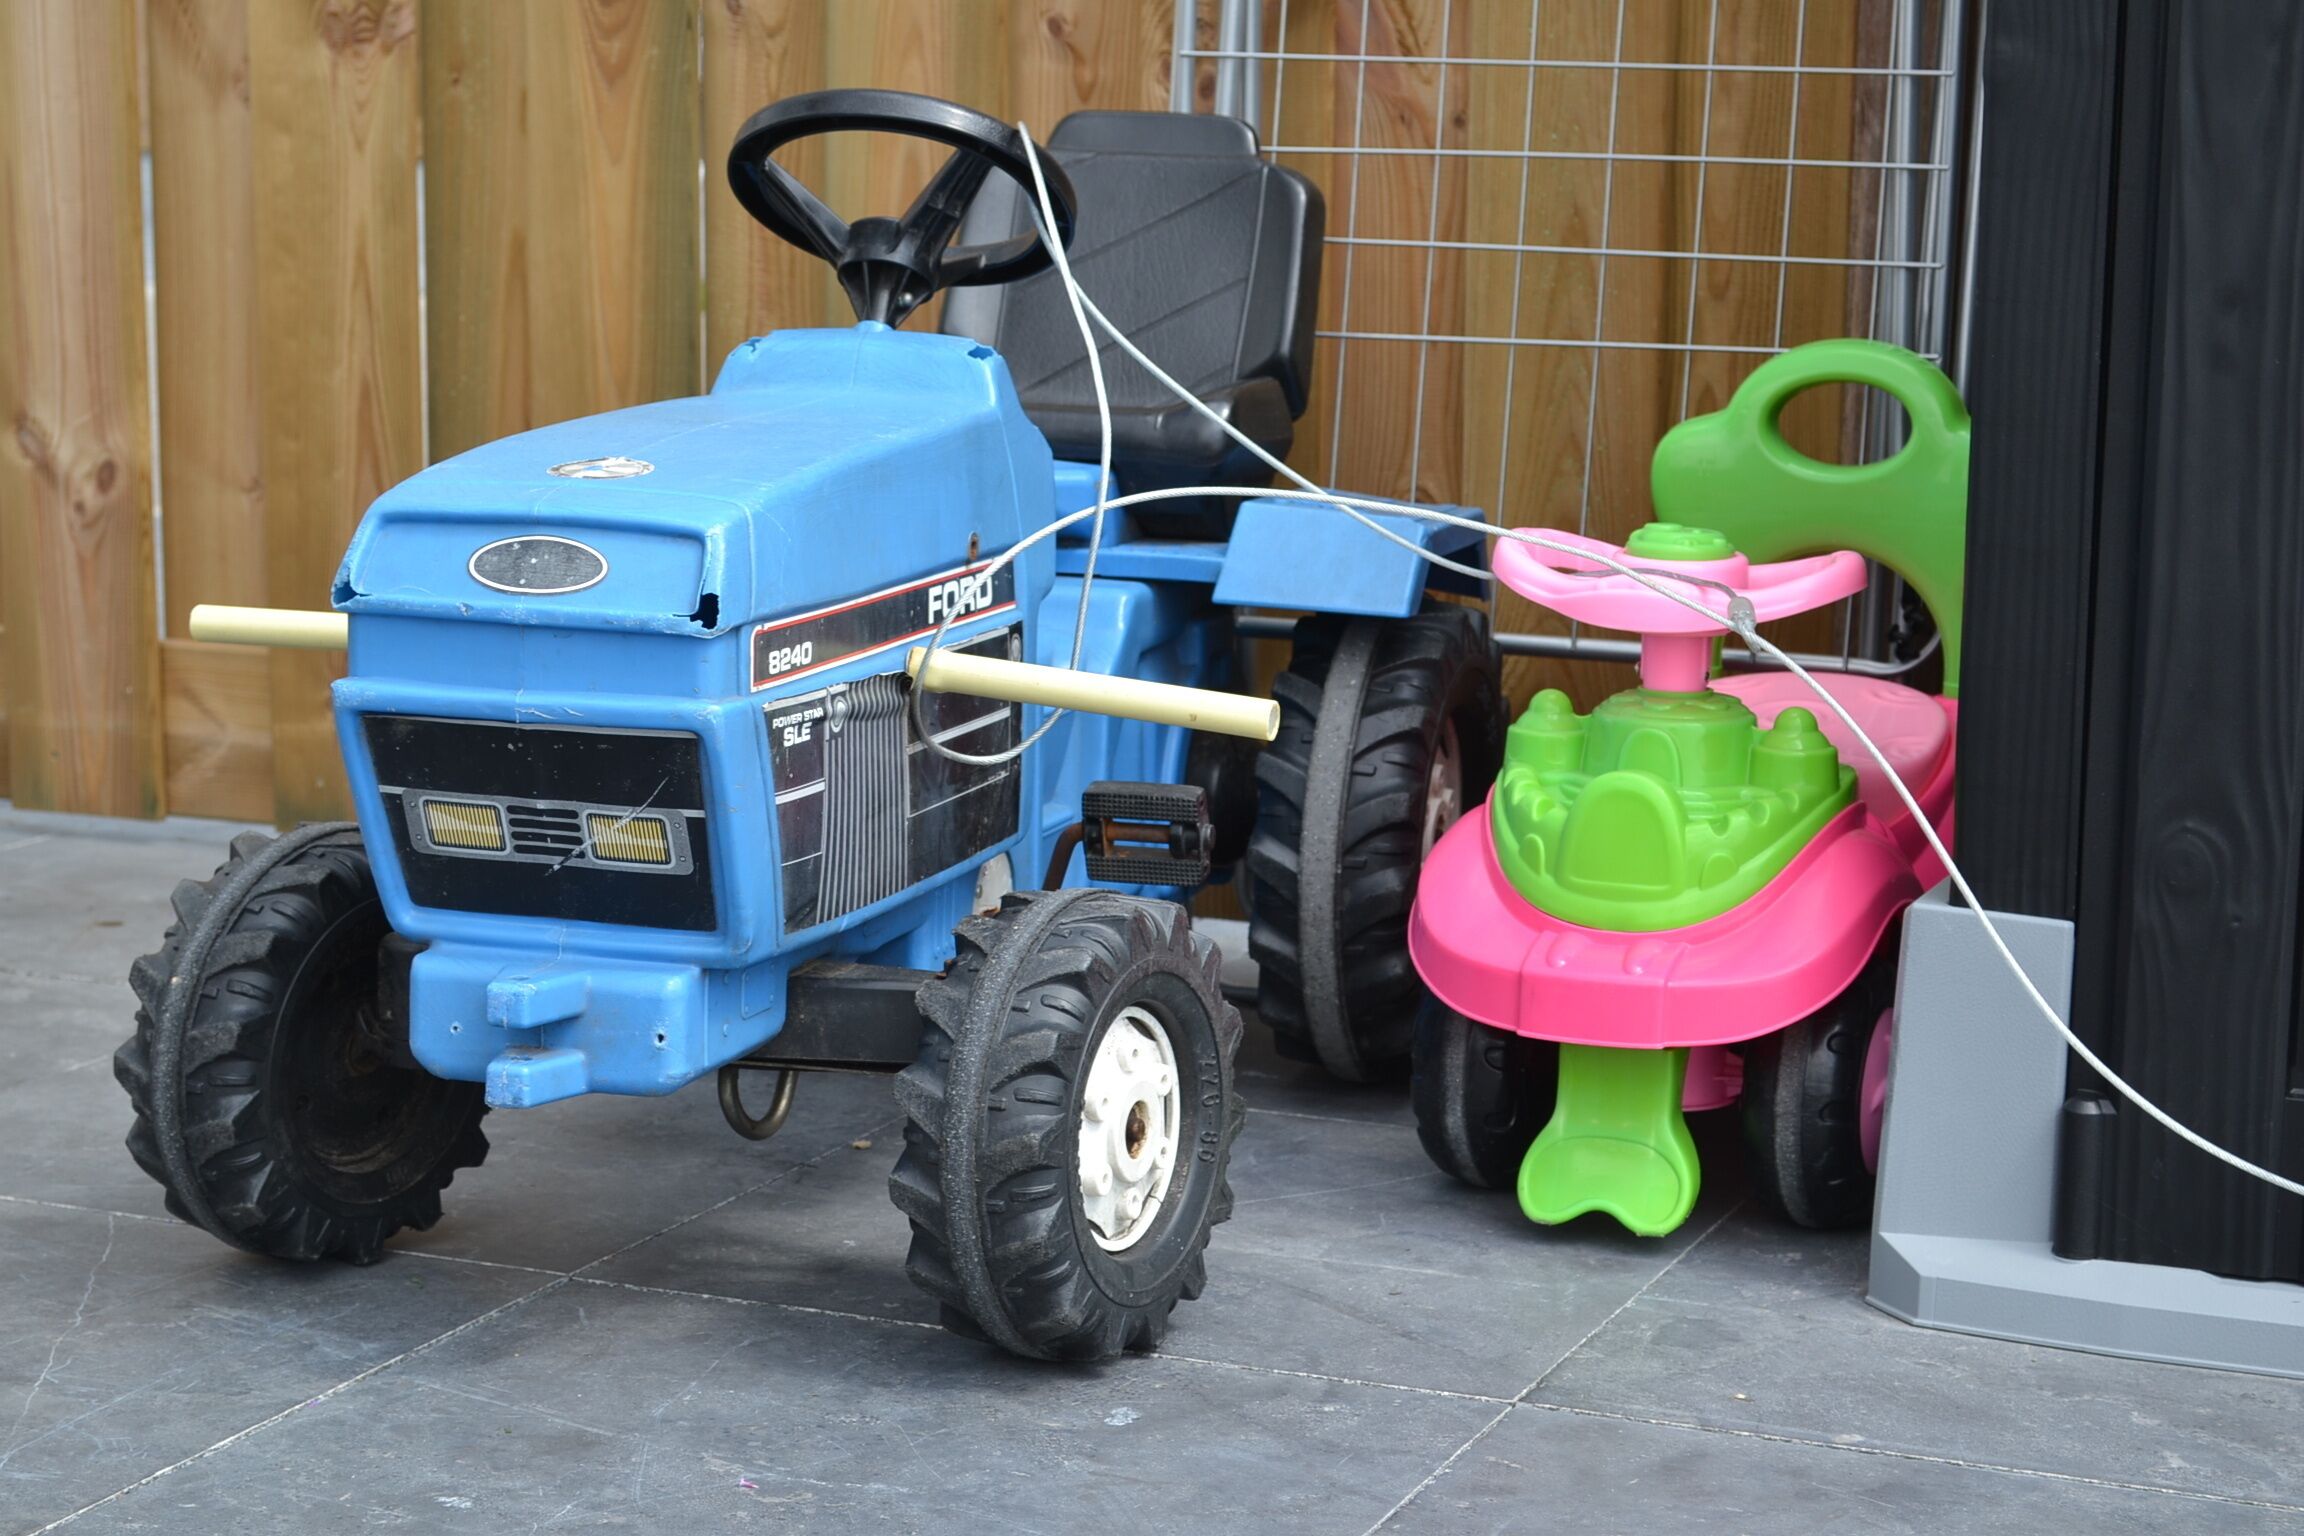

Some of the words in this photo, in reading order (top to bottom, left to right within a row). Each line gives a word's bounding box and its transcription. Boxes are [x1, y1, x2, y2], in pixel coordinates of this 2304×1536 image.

[928, 573, 993, 625] FORD
[769, 641, 812, 675] 8240
[772, 712, 803, 730] POWER
[803, 707, 824, 721] STAR
[783, 721, 812, 747] SLE
